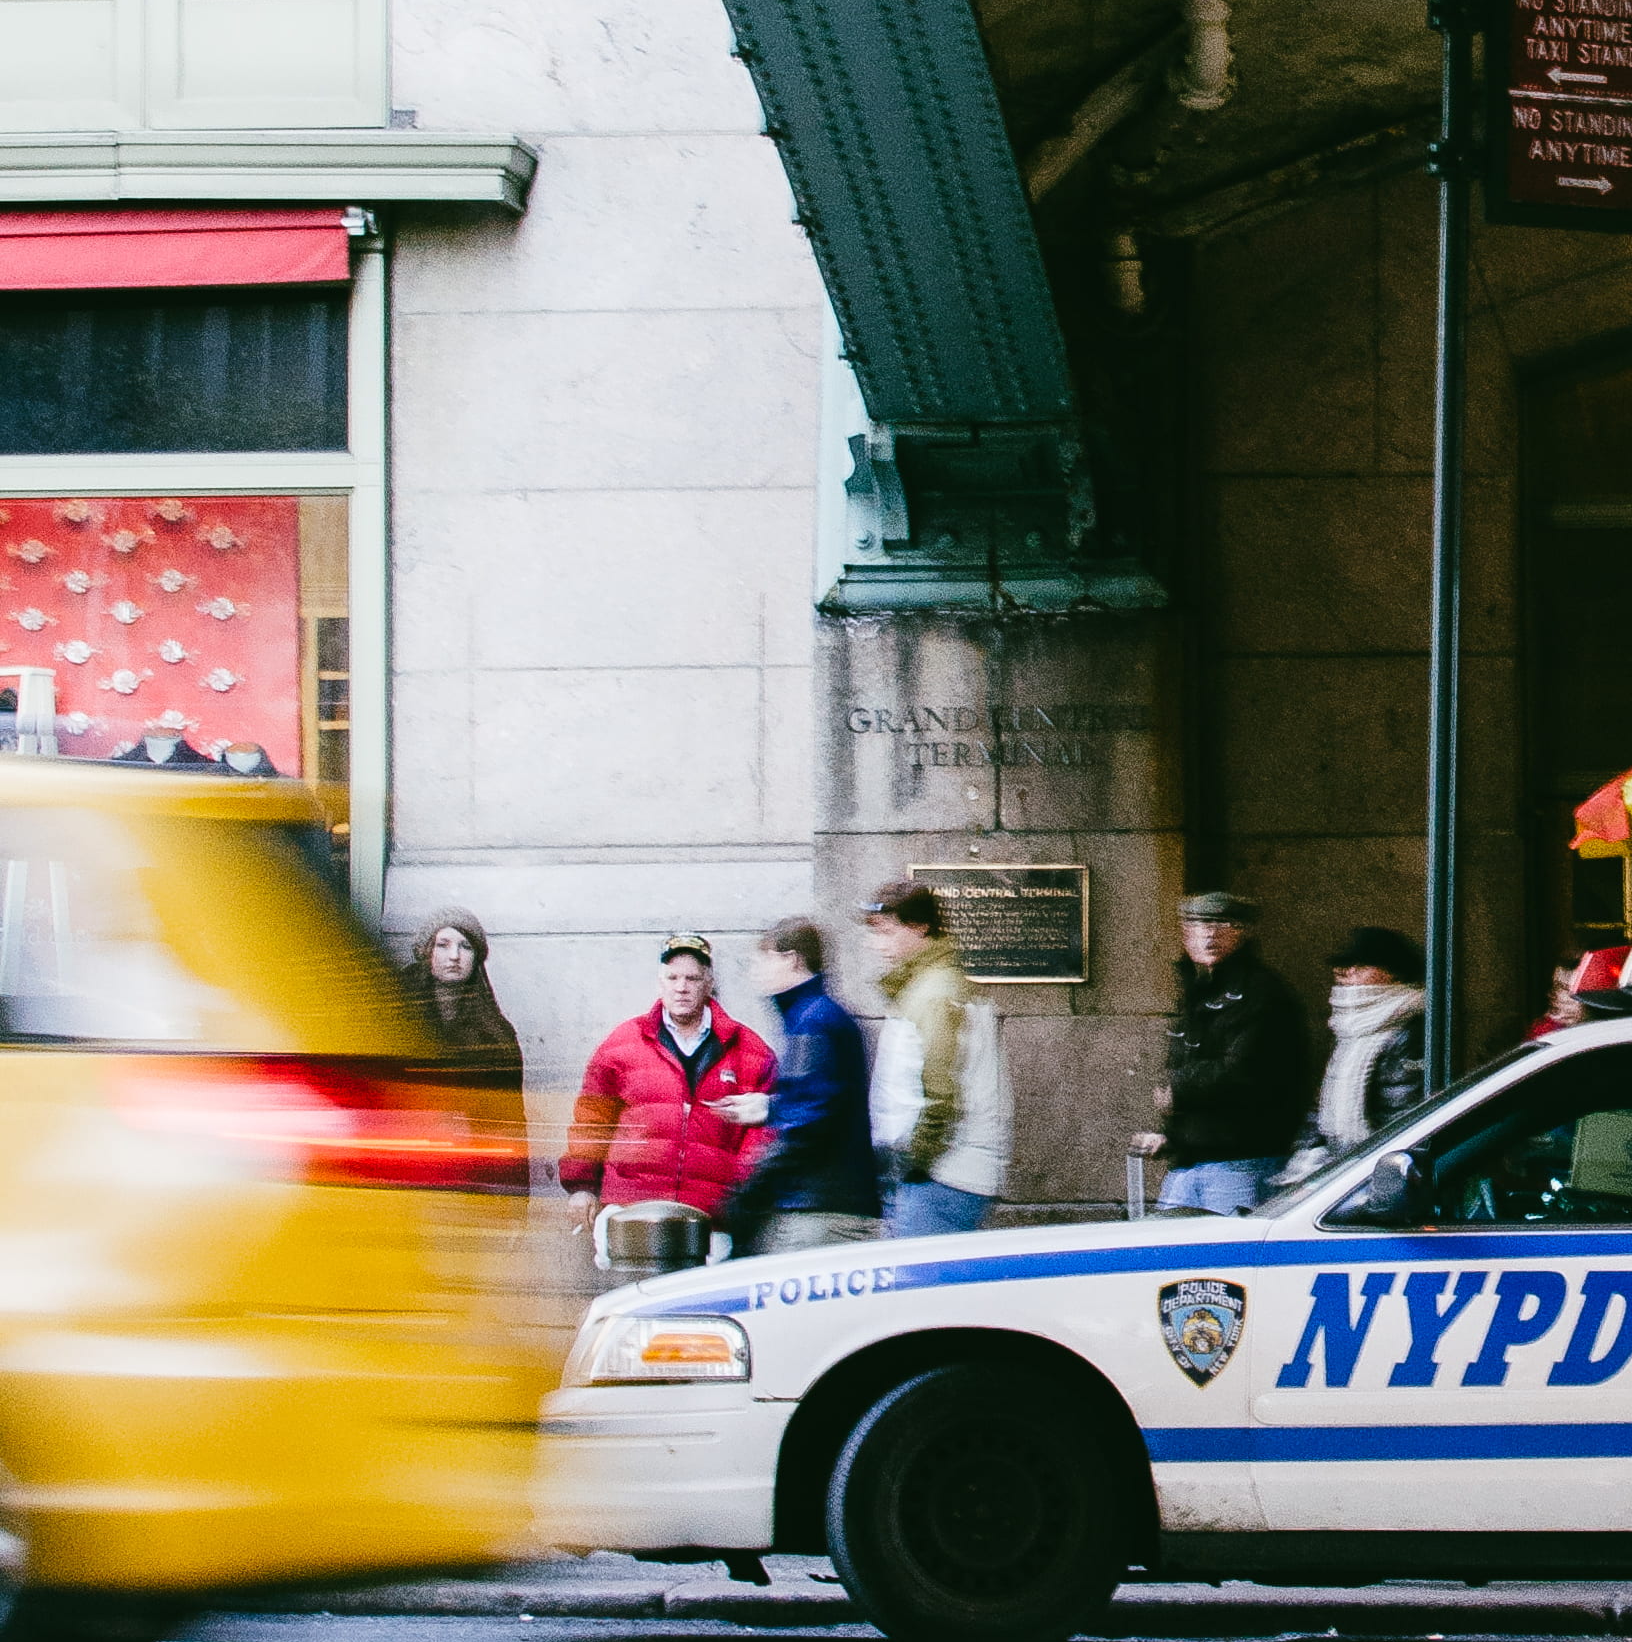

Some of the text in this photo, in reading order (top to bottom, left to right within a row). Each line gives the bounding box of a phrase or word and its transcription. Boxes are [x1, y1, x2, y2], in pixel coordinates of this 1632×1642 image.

[1534, 15, 1632, 44] ANYTIME
[1526, 37, 1569, 63] TAXI
[1512, 106, 1542, 131] NO
[1528, 138, 1632, 169] ANYTIME
[845, 706, 982, 735] GRAND
[962, 887, 1018, 899] CENTRAL
[754, 1265, 895, 1310] POLICE
[1178, 1281, 1228, 1295] POLICE
[1162, 1292, 1243, 1313] DEPARTMENT
[1209, 1317, 1244, 1377] NEW YORK
